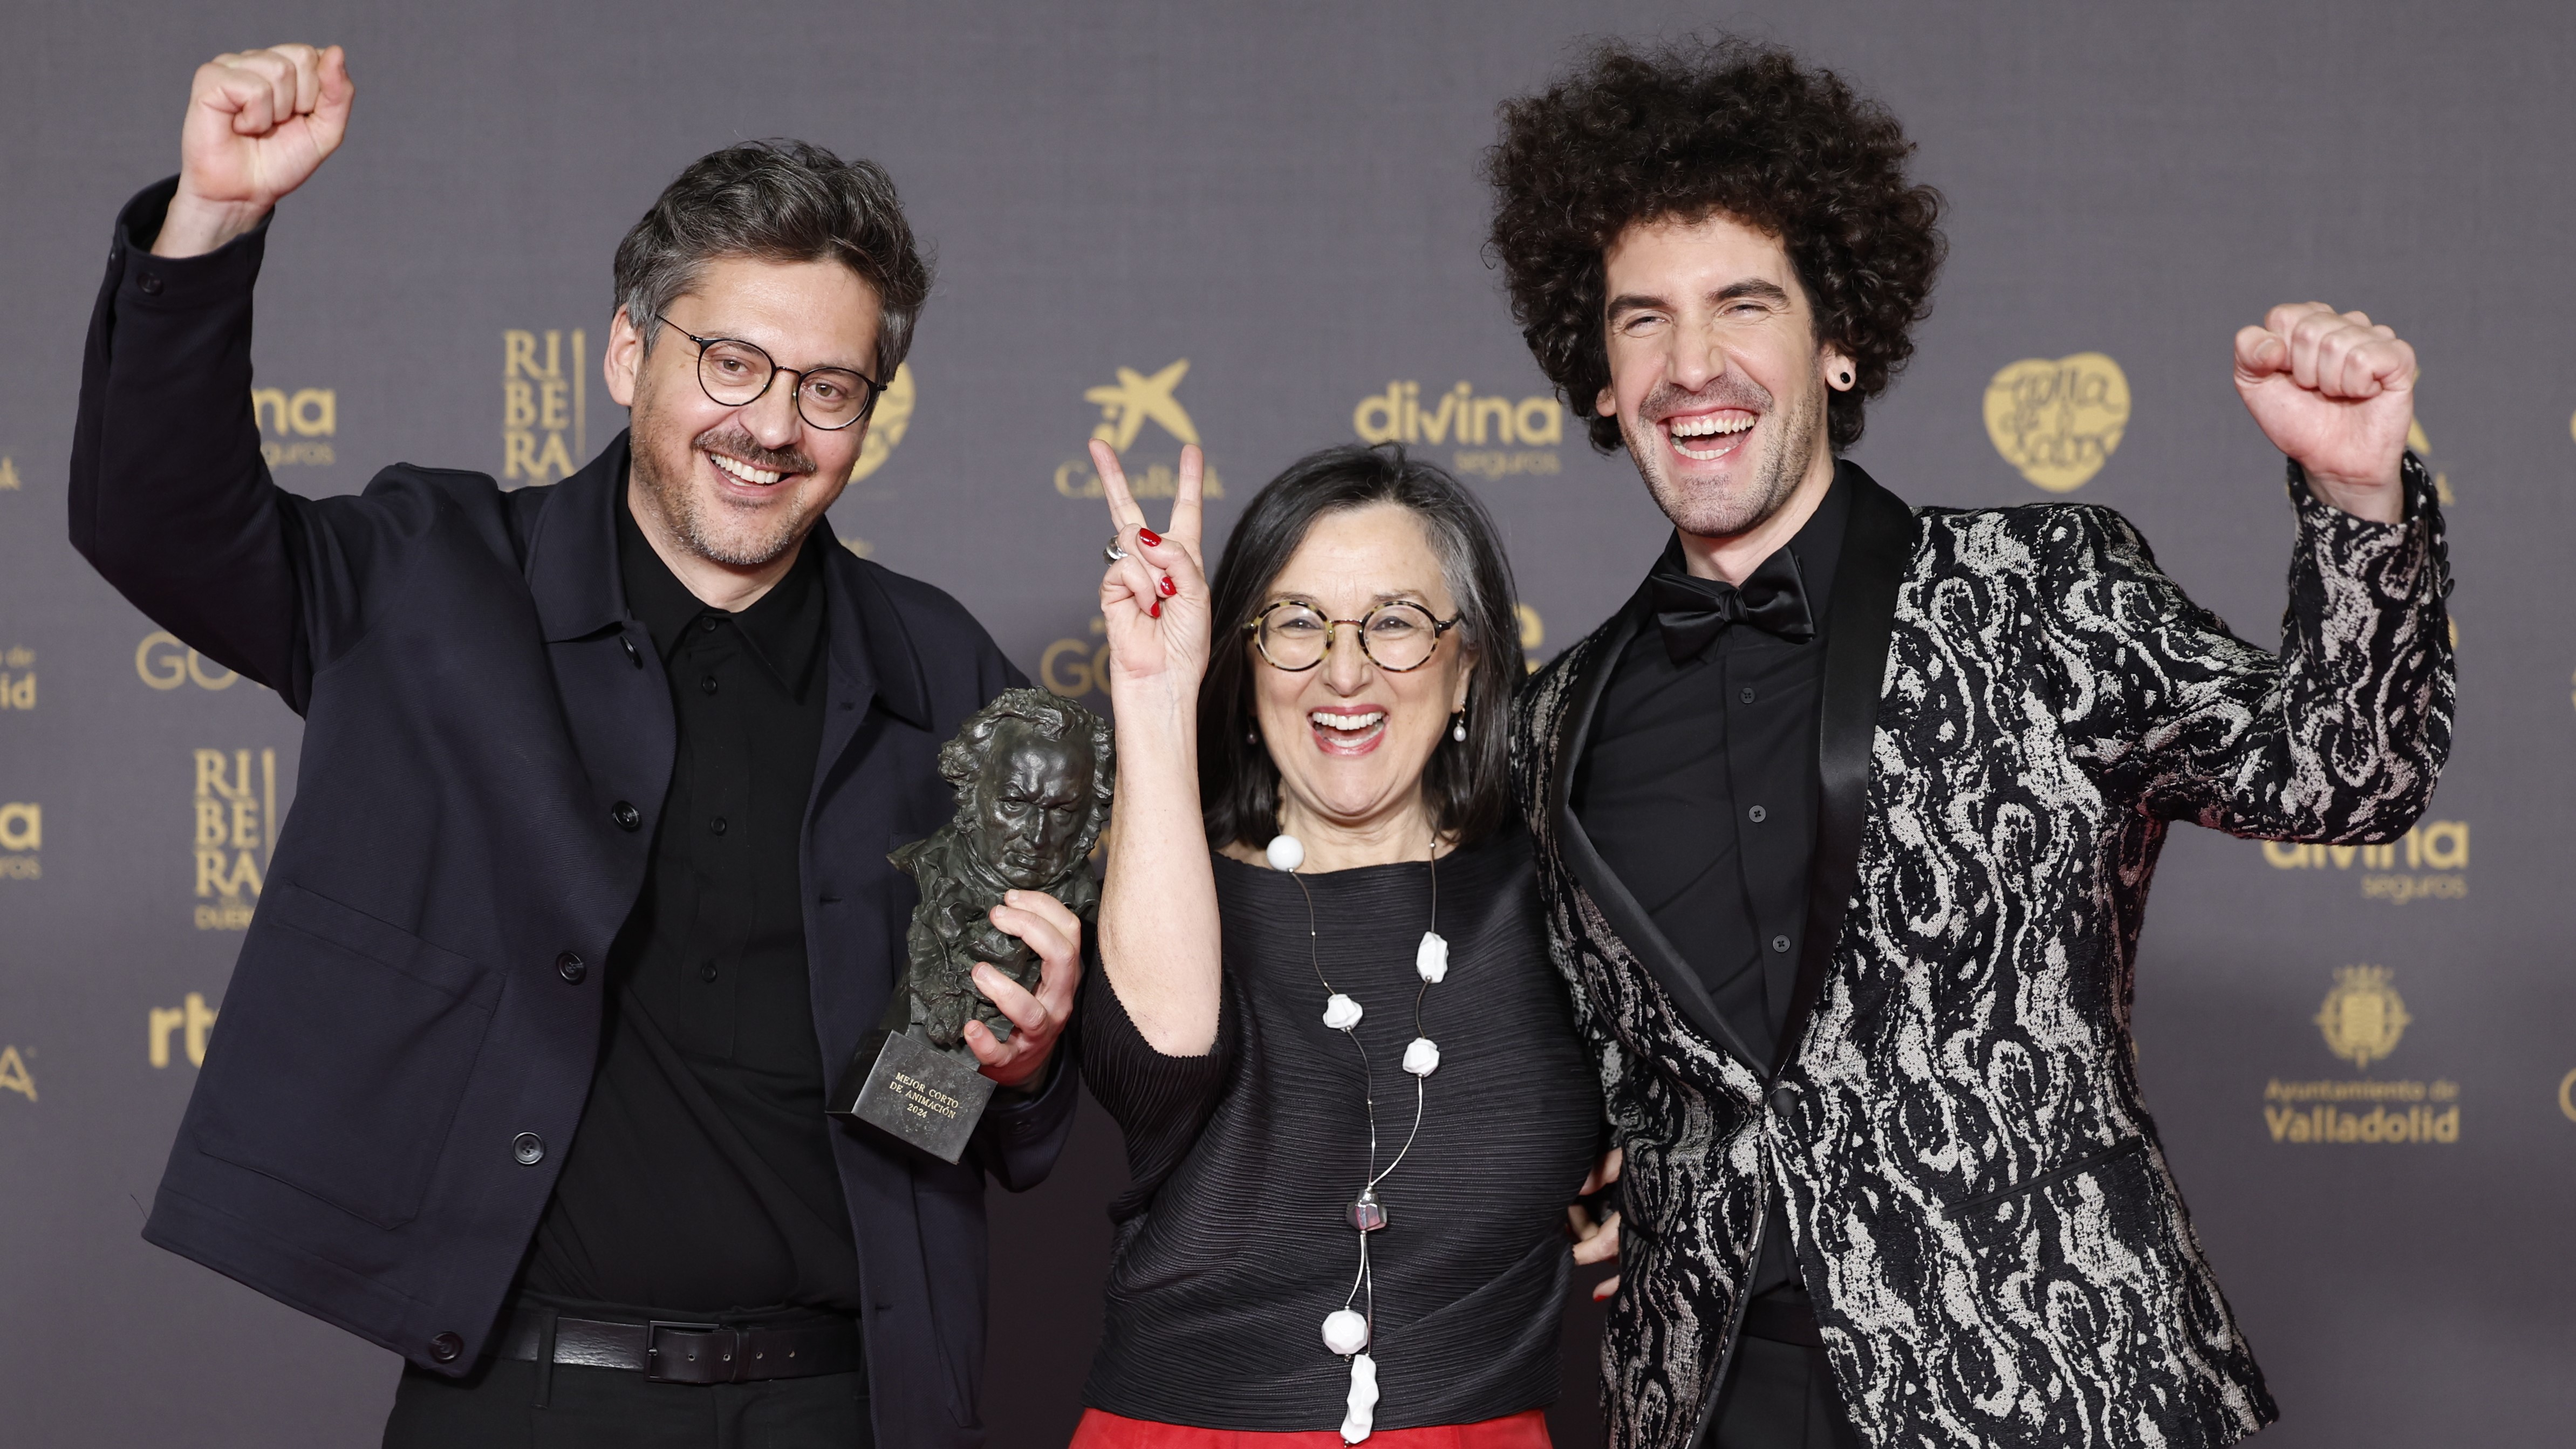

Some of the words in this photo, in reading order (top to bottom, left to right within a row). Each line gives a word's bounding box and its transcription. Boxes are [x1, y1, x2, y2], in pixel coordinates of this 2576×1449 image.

[1353, 381, 1562, 445] divina
[889, 1081, 904, 1093] DE
[905, 1089, 956, 1119] ANIMACIÓN
[895, 1072, 926, 1093] MEJOR
[928, 1089, 959, 1109] CORTO
[906, 1103, 928, 1119] 2024
[2264, 1105, 2459, 1144] Valladolid
